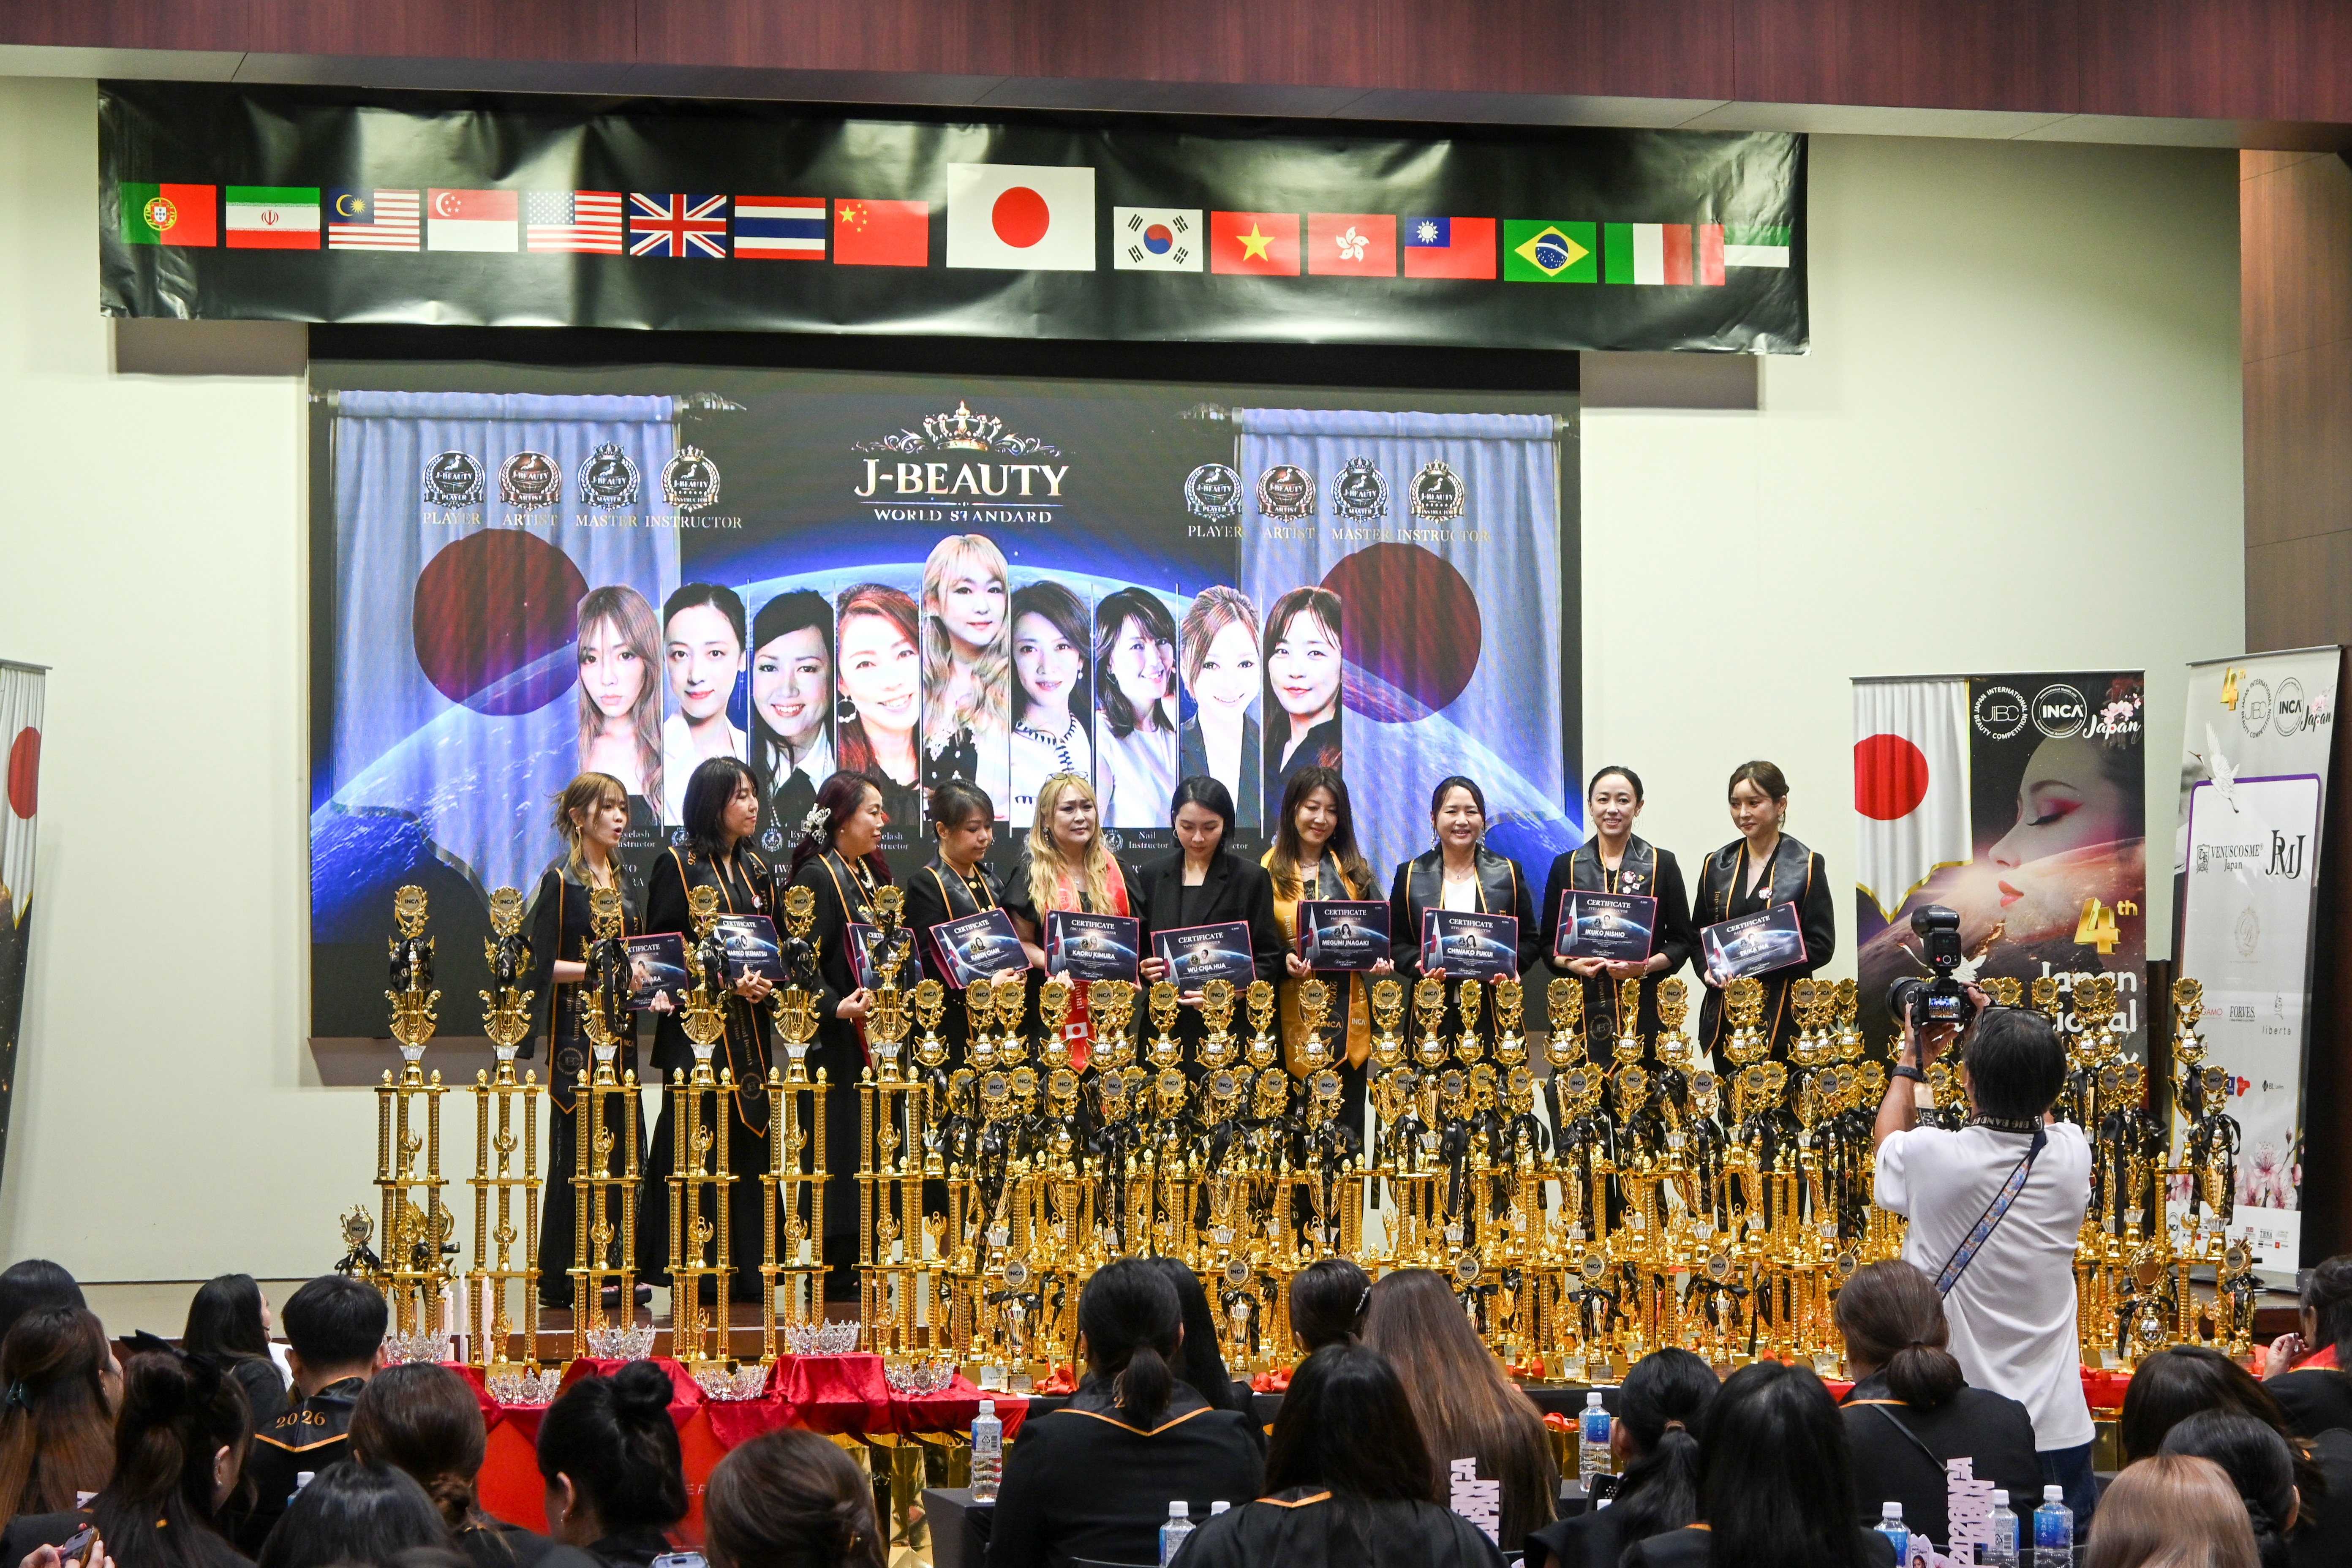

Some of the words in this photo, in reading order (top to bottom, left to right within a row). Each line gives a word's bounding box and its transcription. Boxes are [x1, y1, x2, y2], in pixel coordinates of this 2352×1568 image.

[436, 471, 473, 480] J-BEAUTY
[512, 471, 549, 480] J-BEAUTY
[591, 476, 626, 485] J-BEAUTY
[854, 459, 1069, 496] J-BEAUTY
[673, 480, 708, 488] J-BEAUTY
[1197, 484, 1232, 493] J-BEAUTY
[1269, 483, 1304, 492] J-BEAUTY
[1344, 489, 1377, 498] J-BEAUTY
[423, 512, 480, 525] PLAYER
[503, 513, 558, 526] ARTIST
[576, 515, 637, 527] MASTER
[645, 516, 742, 528] INSTRUCTOR
[874, 509, 942, 521] WORLD
[950, 509, 1052, 523] STANDARD
[1188, 525, 1243, 537] PLAYER
[1263, 527, 1315, 539] ARTIST
[1331, 528, 1390, 540] MASTER
[1398, 529, 1489, 542] INSTRUCTOR
[1974, 693, 1987, 713] JAPAN
[1986, 686, 2028, 713] INTERNATIONAL
[2250, 678, 2272, 708] INTERNATIONAL
[2042, 704, 2084, 718] INCA
[2279, 700, 2302, 714] INCA
[2241, 711, 2250, 735] BEAUTY
[2250, 709, 2271, 738] COMPETITION
[2300, 705, 2331, 732] Japan
[1974, 714, 1991, 736] BEAUTY
[1992, 713, 2028, 739] COMPETITION
[2037, 719, 2054, 735] Competition
[2082, 714, 2141, 740] Japan
[621, 830, 650, 838] yelash
[2211, 844, 2260, 859] VENUSCOSME
[687, 851, 696, 866] 26
[2224, 859, 2242, 872] Japan
[1587, 898, 1631, 909] CERTIFICATE
[954, 919, 989, 934] CERTIFICATE
[1071, 919, 1115, 929] CERTIFICATE
[1284, 915, 1293, 937] Japan
[1449, 918, 1493, 928] CERTIFICATE
[1726, 915, 1771, 933] CERTIFICATE
[2074, 897, 2138, 955] 4th
[1178, 932, 1223, 944] CERTIFICATE
[627, 944, 660, 953] RTIFICATE
[970, 951, 986, 961] KAREN
[987, 947, 1000, 956] CHAN
[1447, 947, 1475, 957] CHIWAKO
[1740, 947, 1756, 956] ERIKA
[1757, 944, 1769, 952] INA
[1093, 952, 1115, 960] KIMURA
[2042, 961, 2137, 993] Jan
[1328, 980, 1338, 1005] 2026
[2201, 1008, 2223, 1016] GAMO
[2262, 1024, 2291, 1035] liberta
[275, 1410, 326, 1429] 2026
[1473, 1480, 1500, 1546] APAN
